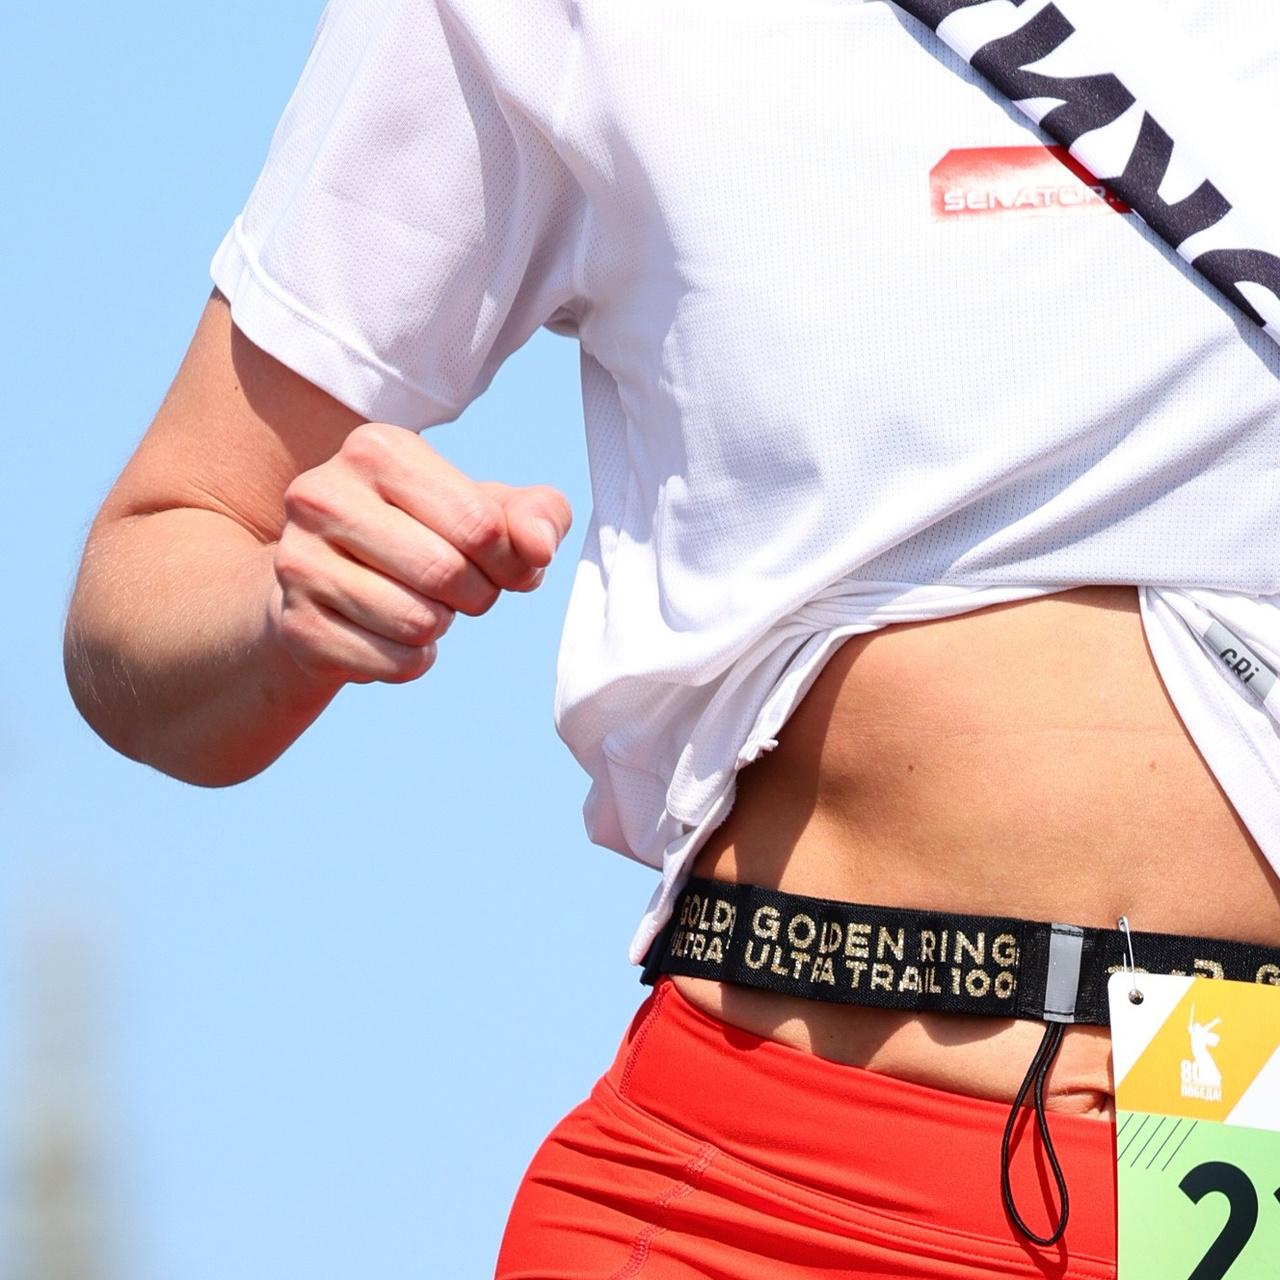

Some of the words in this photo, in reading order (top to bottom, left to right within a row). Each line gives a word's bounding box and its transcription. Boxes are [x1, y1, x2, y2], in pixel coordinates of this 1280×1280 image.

[943, 184, 1120, 212] SENATOR.
[921, 929, 1017, 967] RING
[951, 966, 1017, 999] 100
